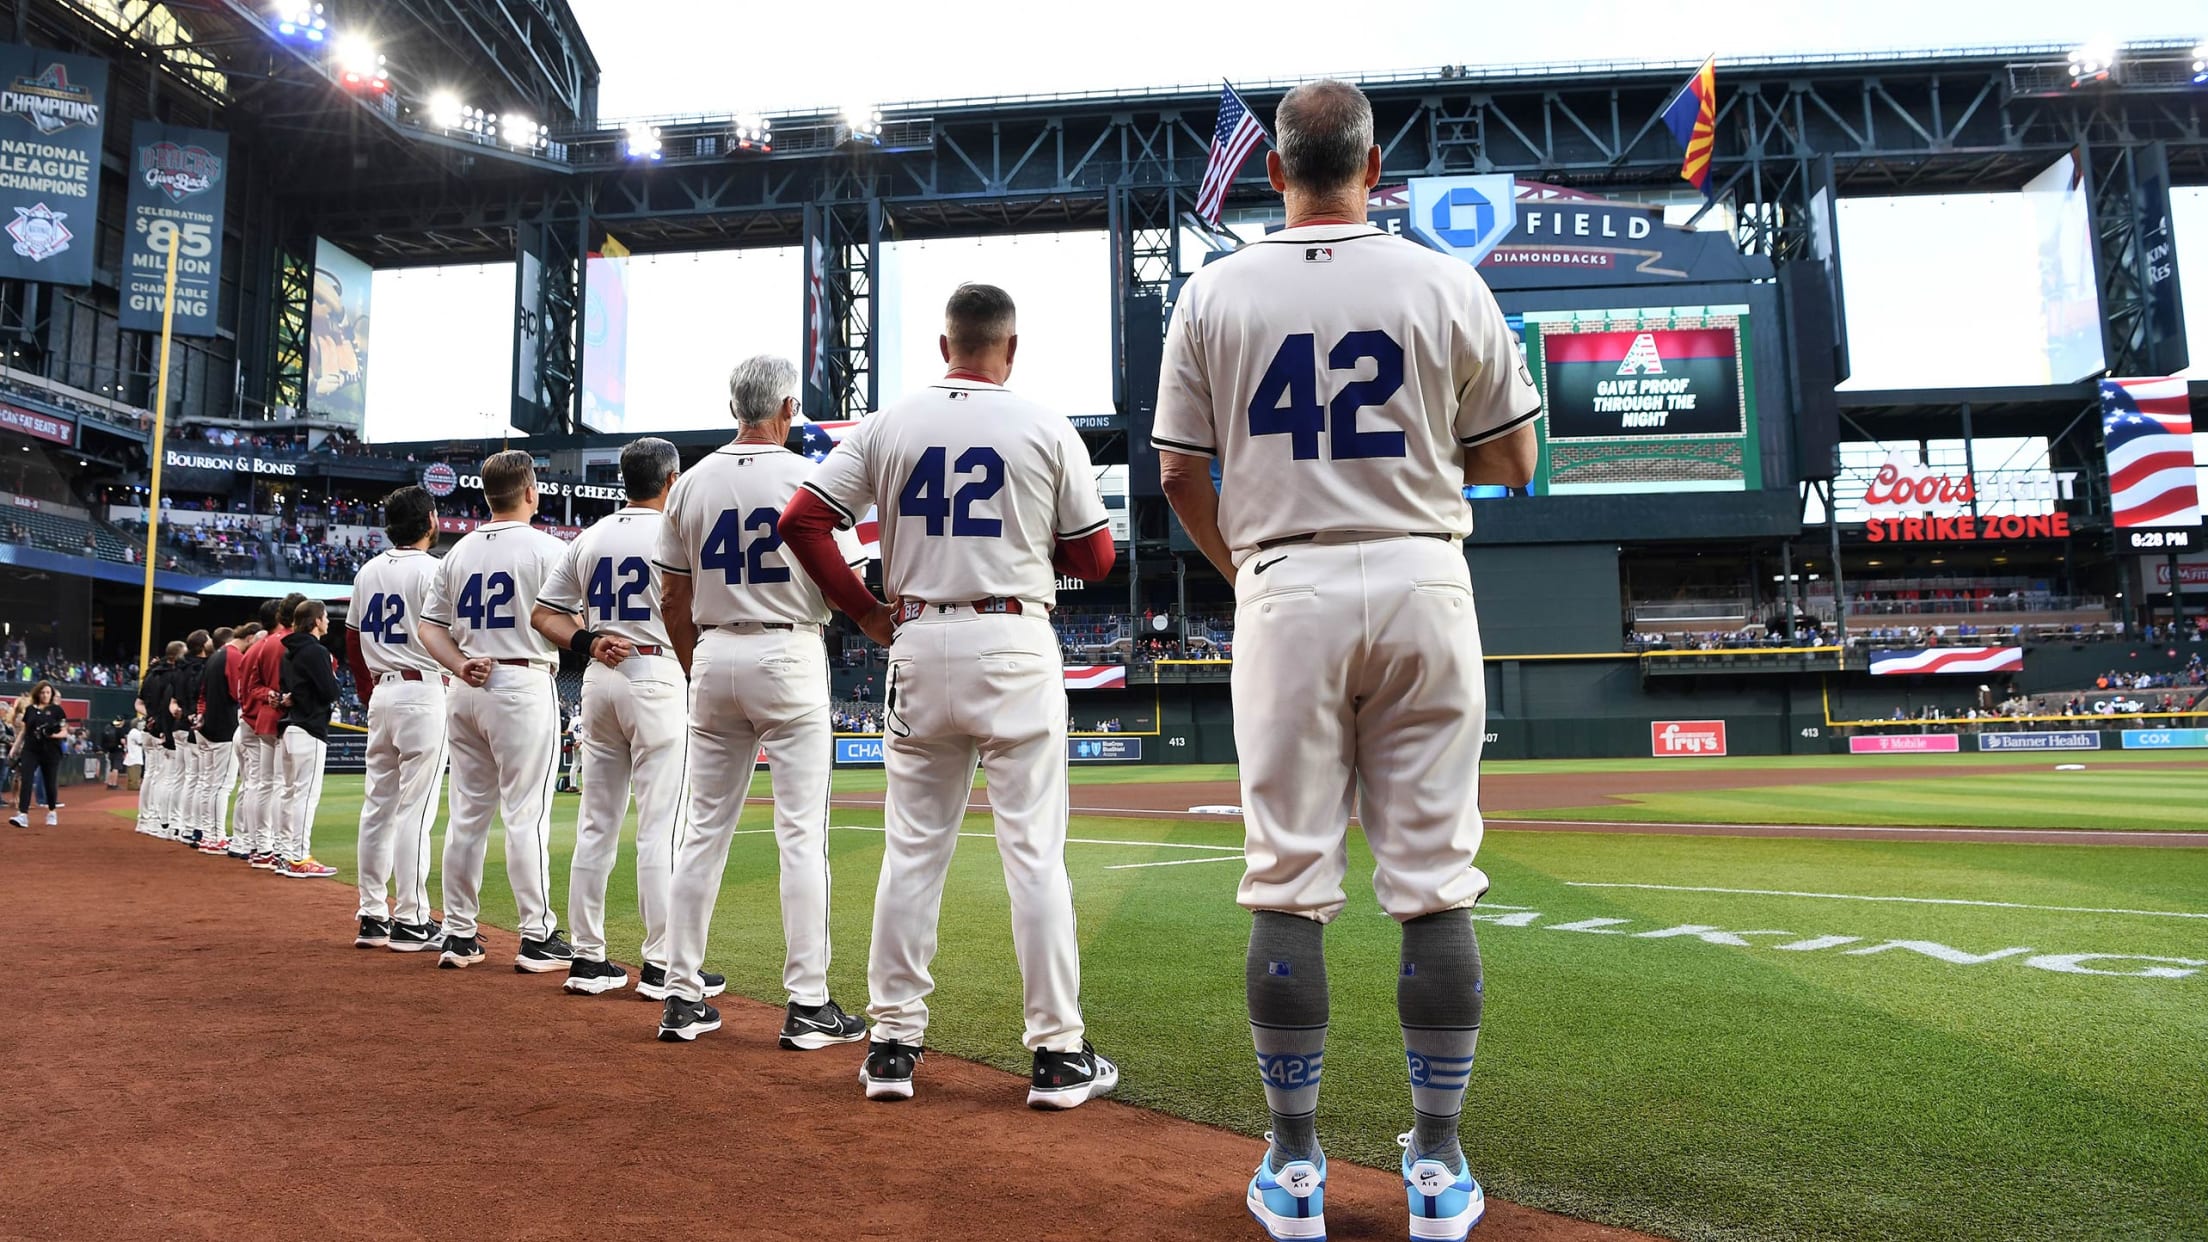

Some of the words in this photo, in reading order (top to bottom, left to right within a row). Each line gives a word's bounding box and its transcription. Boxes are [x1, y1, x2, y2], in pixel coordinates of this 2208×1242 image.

[1, 91, 98, 126] CHAMPIONS
[1, 139, 89, 164] NATIONAL
[0, 155, 88, 181] LEAGUE
[0, 173, 87, 198] CHAMPIONS
[136, 206, 213, 224] CELEBRATING
[1527, 212, 1651, 239] FIELD
[132, 253, 211, 275] MILION
[1494, 253, 1607, 265] DIAMONDBACKS
[1247, 328, 1406, 461] 42
[1597, 379, 1638, 396] GAVE
[1639, 378, 1690, 395] PROOF
[1593, 395, 1665, 412] THROUGH
[1667, 394, 1696, 410] THE
[33, 417, 57, 435] SEATS
[1622, 411, 1669, 428] NIGHT
[236, 457, 250, 471] &
[561, 485, 572, 496] &
[574, 485, 627, 500] CHEES
[899, 446, 1005, 538] 42
[1864, 463, 1975, 505] Coors
[1979, 472, 2078, 501] LIGHT
[1865, 516, 1976, 541] STRIKE
[1982, 511, 2071, 539] ZONE
[700, 507, 791, 585] 42
[2131, 532, 2164, 547] 6:28
[2165, 532, 2188, 546] PM
[587, 557, 651, 621] 42
[1055, 575, 1085, 590] alth
[457, 571, 515, 629] 42
[361, 593, 408, 644] 42
[1169, 737, 1185, 747] 413
[1659, 723, 1718, 753] fry's
[1801, 728, 1819, 738] 413
[2002, 736, 2047, 748] Banner
[2049, 734, 2090, 746] Health
[2139, 734, 2170, 745] COX
[848, 744, 883, 757] CHA
[1270, 1060, 1304, 1084] 42
[1408, 1056, 1424, 1082] 2
